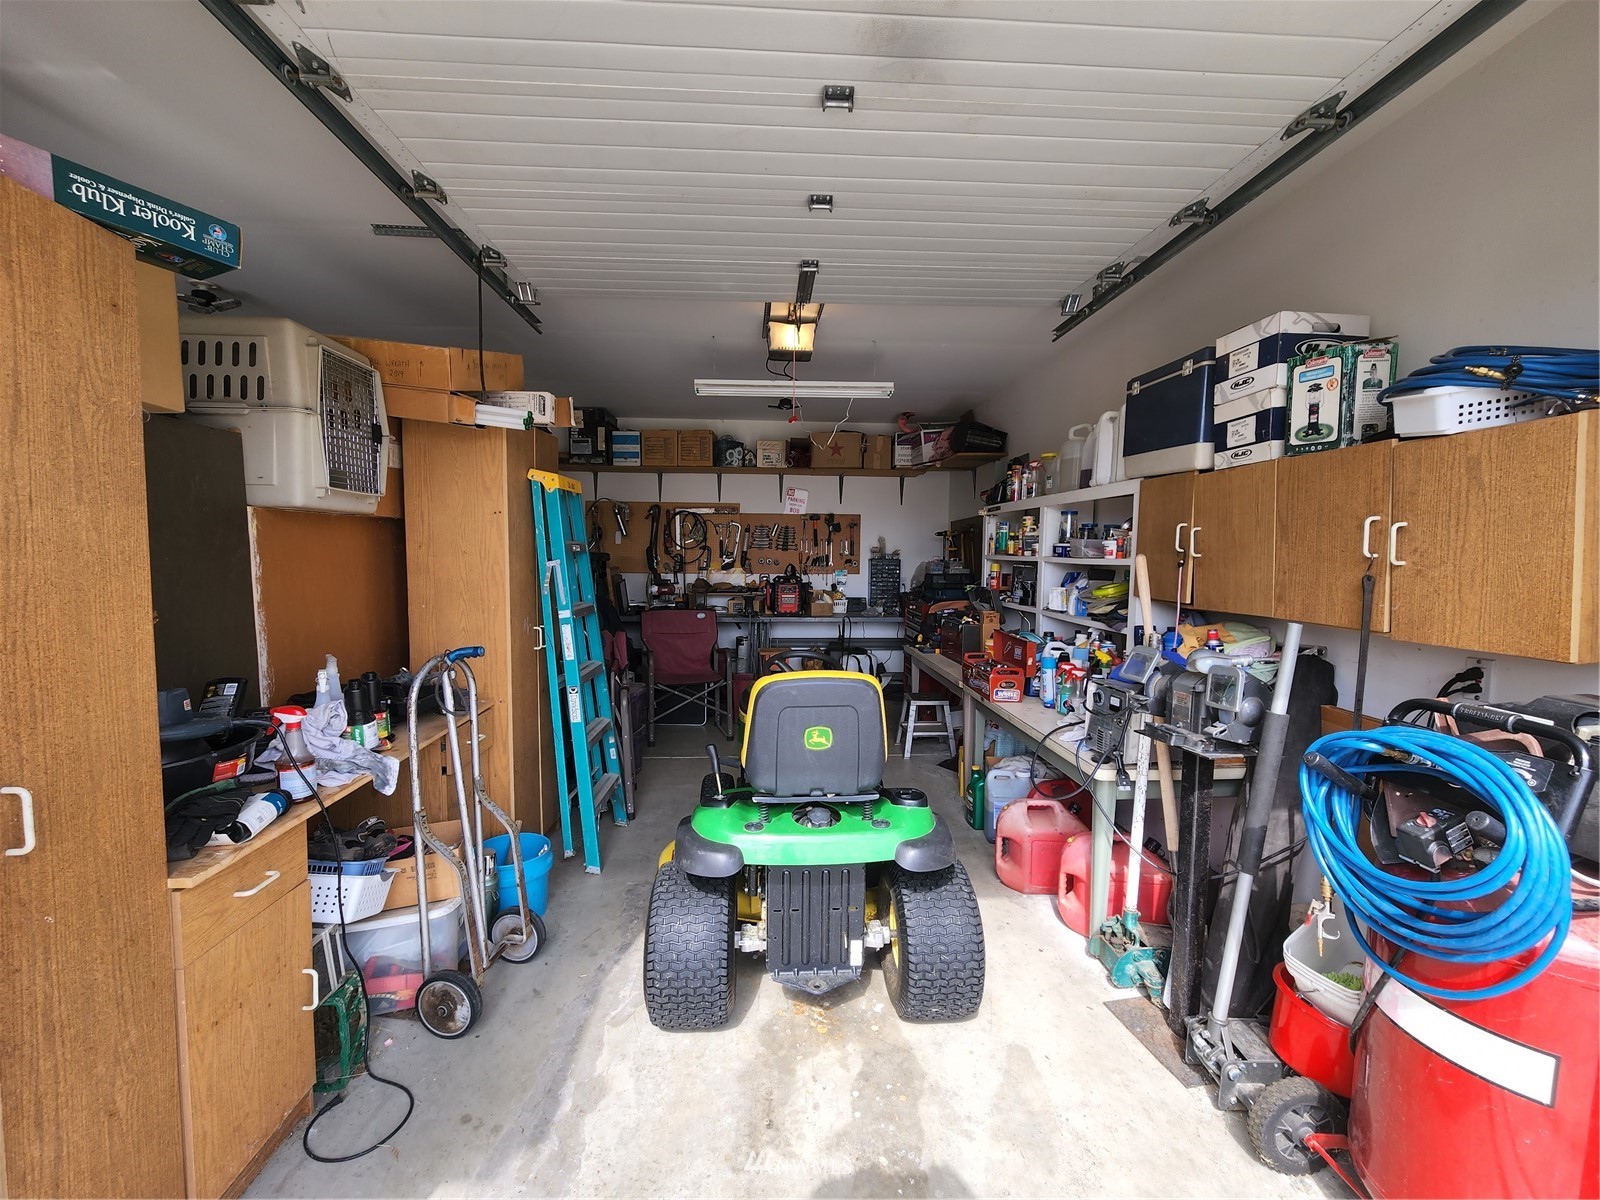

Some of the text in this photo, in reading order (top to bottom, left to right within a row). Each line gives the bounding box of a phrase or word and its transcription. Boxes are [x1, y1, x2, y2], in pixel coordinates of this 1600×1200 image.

[68, 172, 97, 188] Cooler
[107, 186, 146, 206] Dispenser
[72, 182, 197, 241] Kooler Klub
[145, 201, 168, 214] Drink
[168, 209, 196, 224] Golfer's
[202, 238, 234, 254] CHAMP
[206, 244, 230, 257] CLUB
